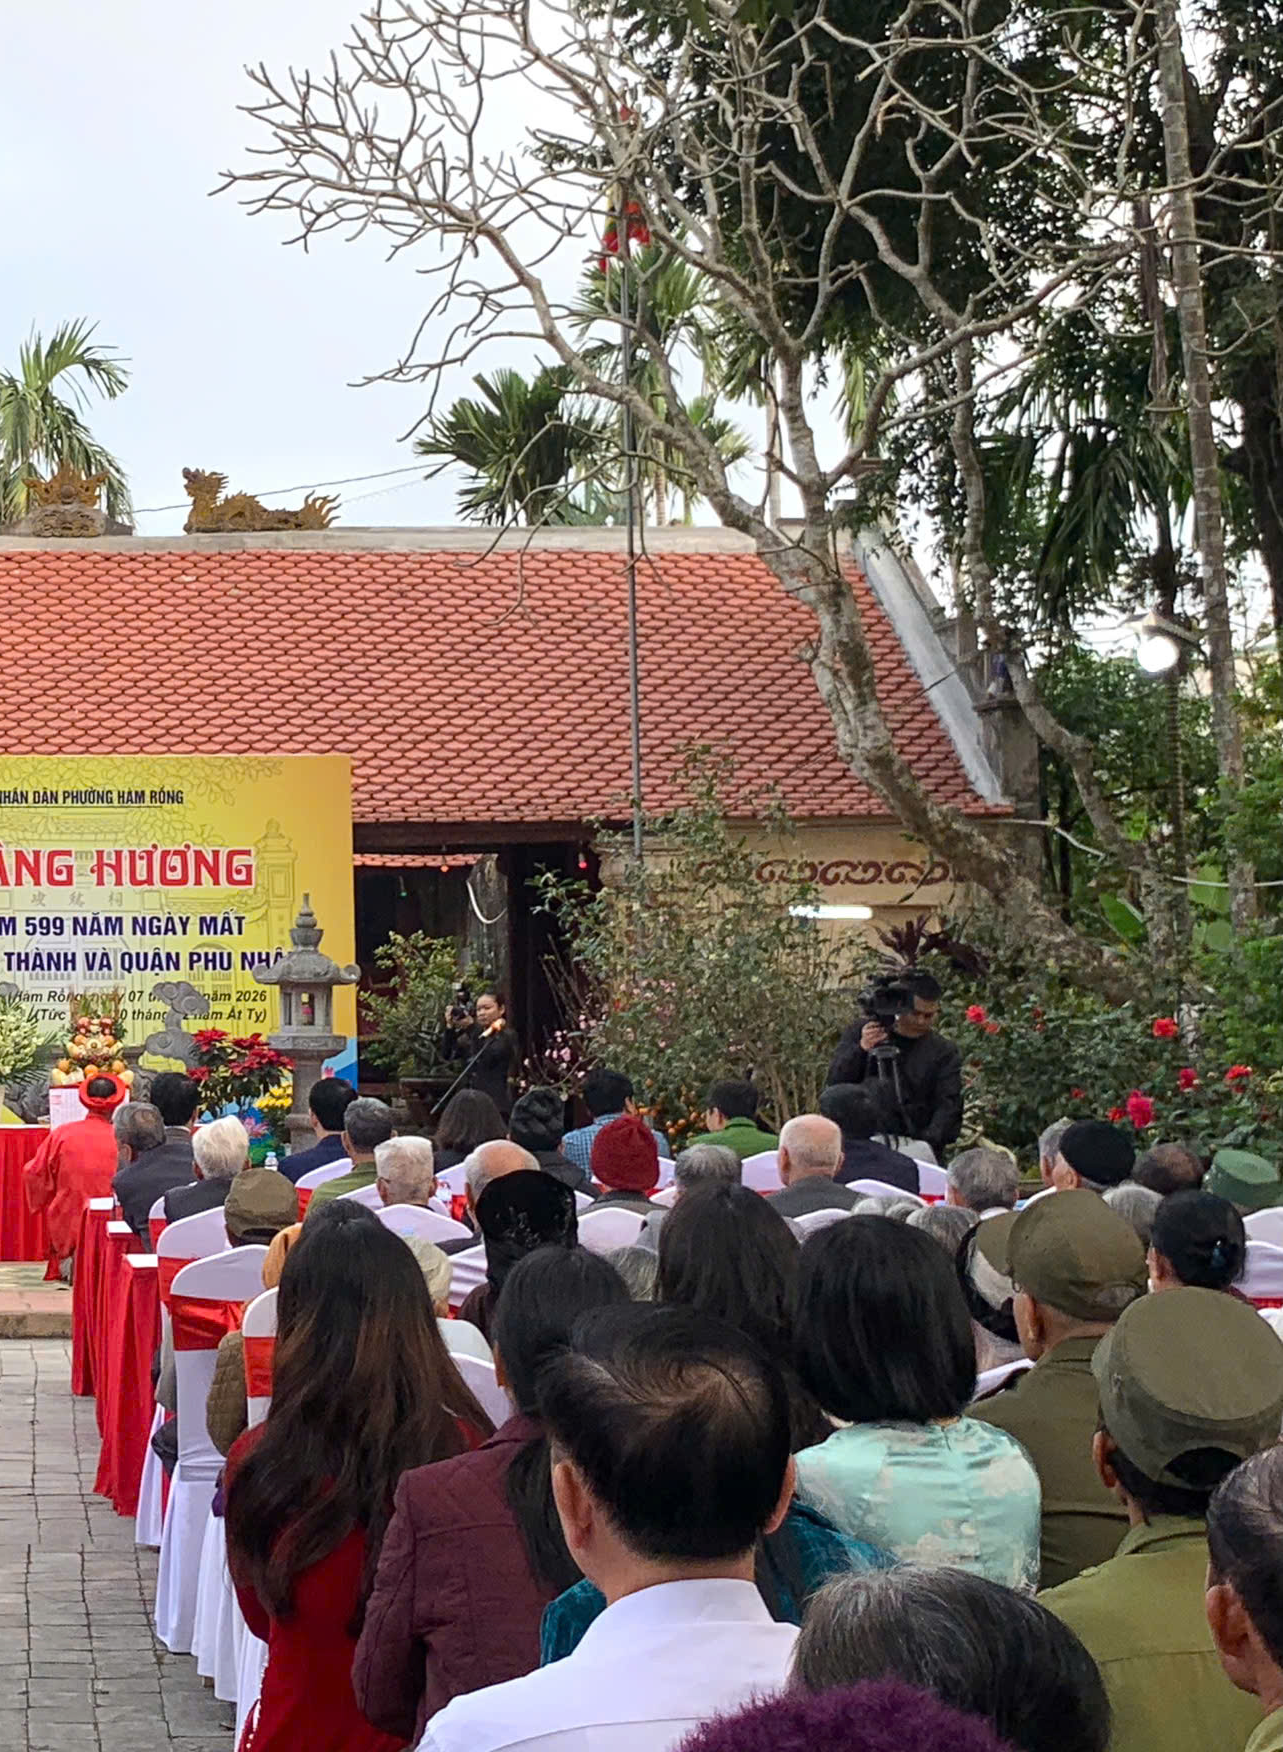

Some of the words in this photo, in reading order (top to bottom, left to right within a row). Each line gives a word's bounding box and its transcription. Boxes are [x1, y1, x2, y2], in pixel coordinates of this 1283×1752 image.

[32, 787, 58, 805] DÂN
[89, 843, 254, 887] HƯƠNG
[24, 916, 65, 936] 599
[72, 911, 124, 936] NĂM
[131, 911, 191, 936] NGÀY
[199, 907, 246, 936] MẤT
[4, 946, 77, 972] THÀNH
[85, 946, 112, 972] VÀ
[120, 946, 181, 976] QUẬN
[188, 951, 232, 972] PHU
[128, 990, 144, 1002] 07
[235, 990, 267, 1002] 2026
